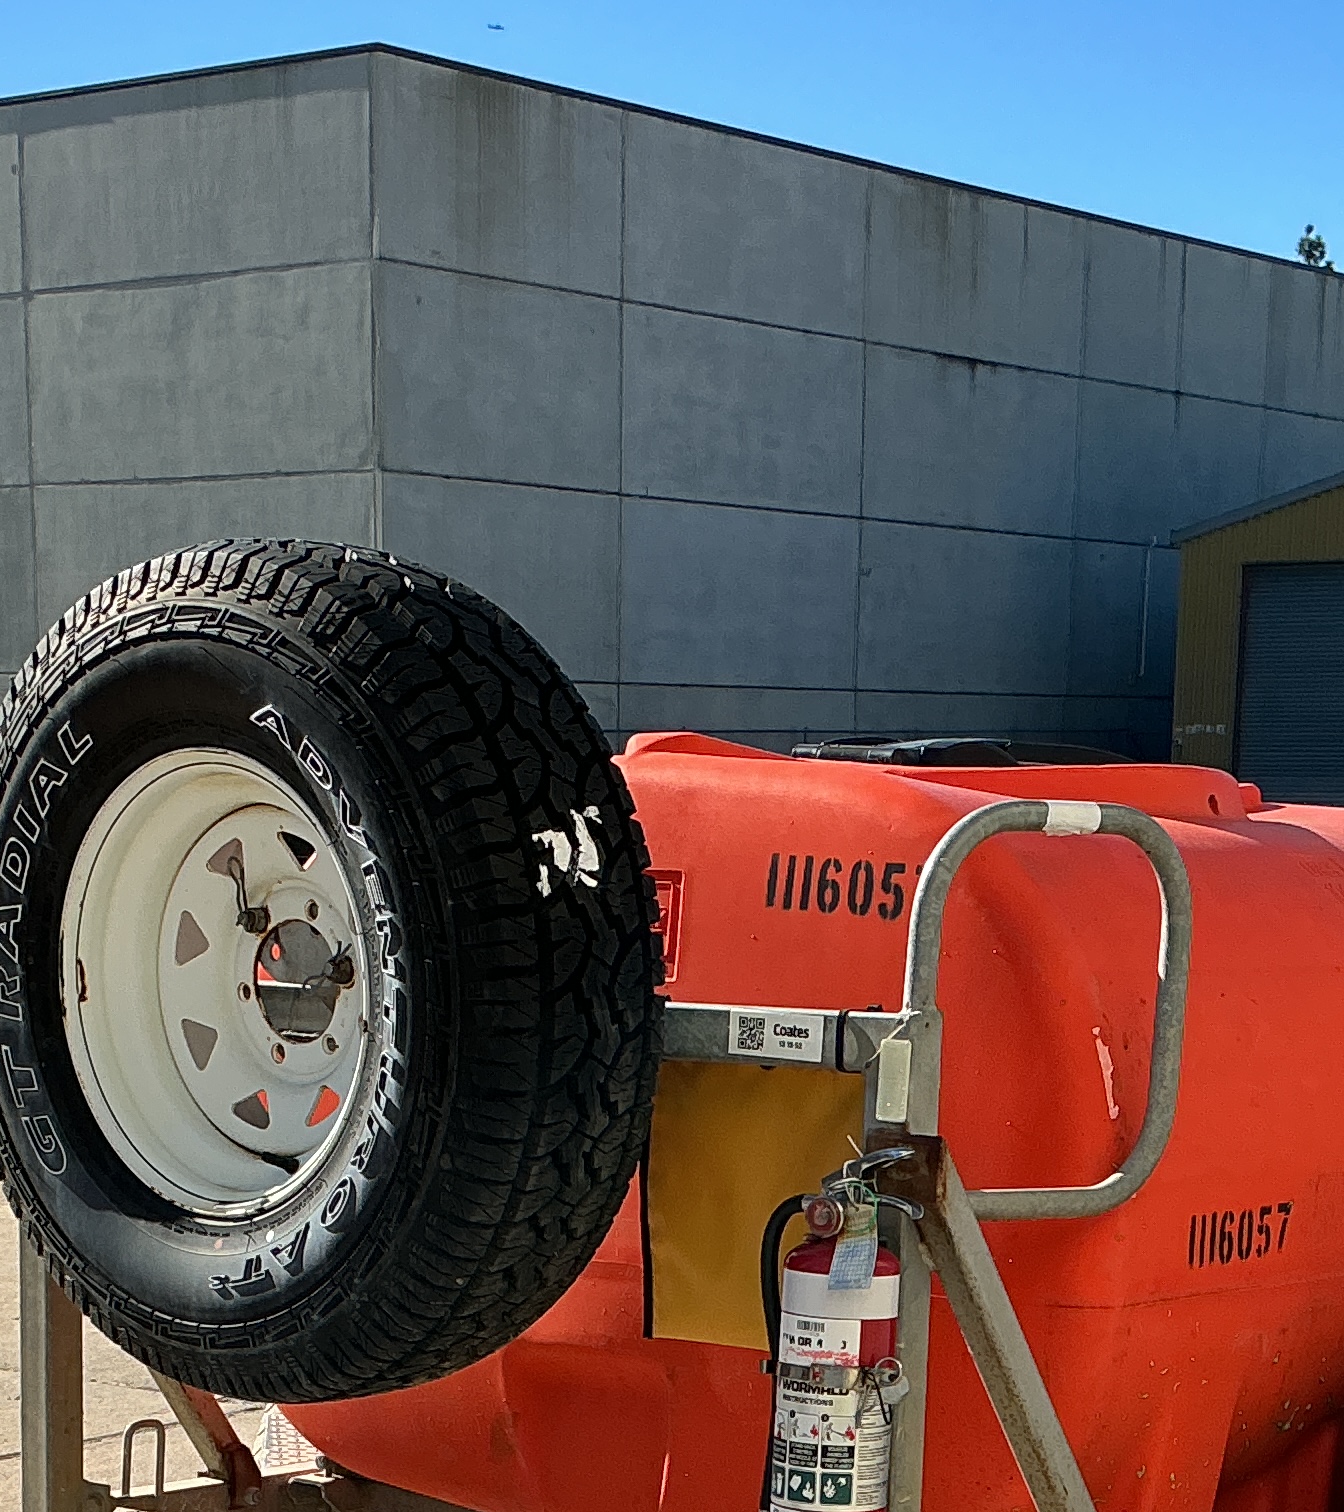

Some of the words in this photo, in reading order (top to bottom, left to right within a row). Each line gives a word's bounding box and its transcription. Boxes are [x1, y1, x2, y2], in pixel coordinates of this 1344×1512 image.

[766, 852, 922, 921] 111605
[249, 703, 407, 1234] ADVENTURO
[773, 1023, 810, 1039] Coates
[2, 1045, 67, 1175] GT
[1188, 1200, 1294, 1268] 1116057
